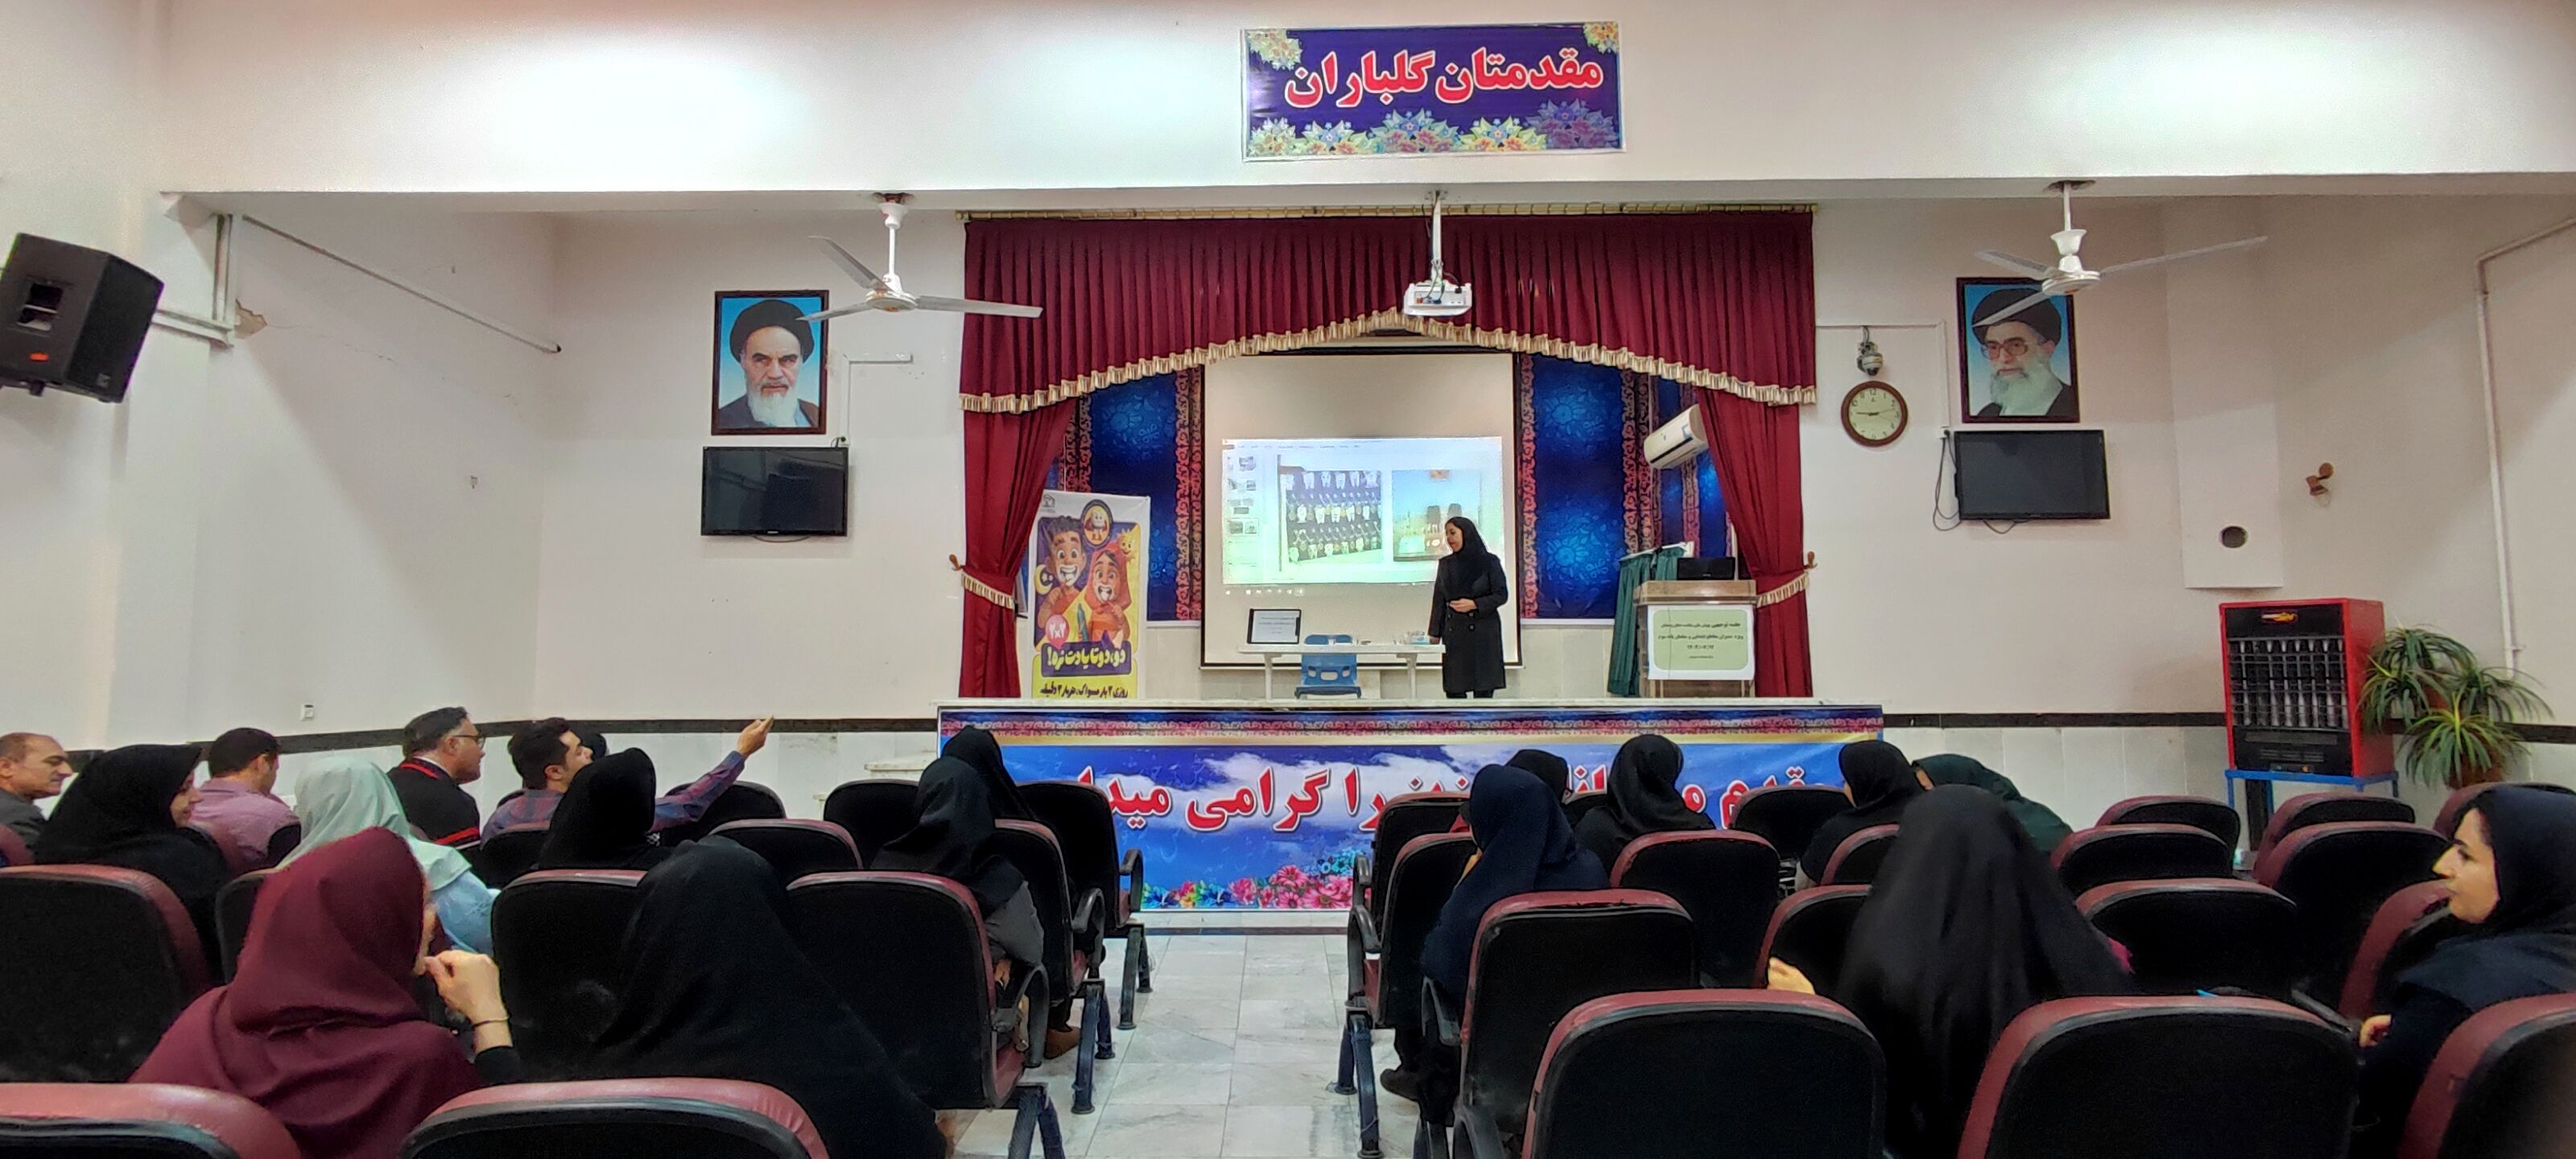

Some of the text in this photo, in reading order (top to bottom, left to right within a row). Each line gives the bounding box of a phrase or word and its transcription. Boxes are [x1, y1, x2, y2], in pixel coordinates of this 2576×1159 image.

[1284, 47, 1604, 108] مقدمتان گلباران
[1186, 765, 1331, 832] گرامی
